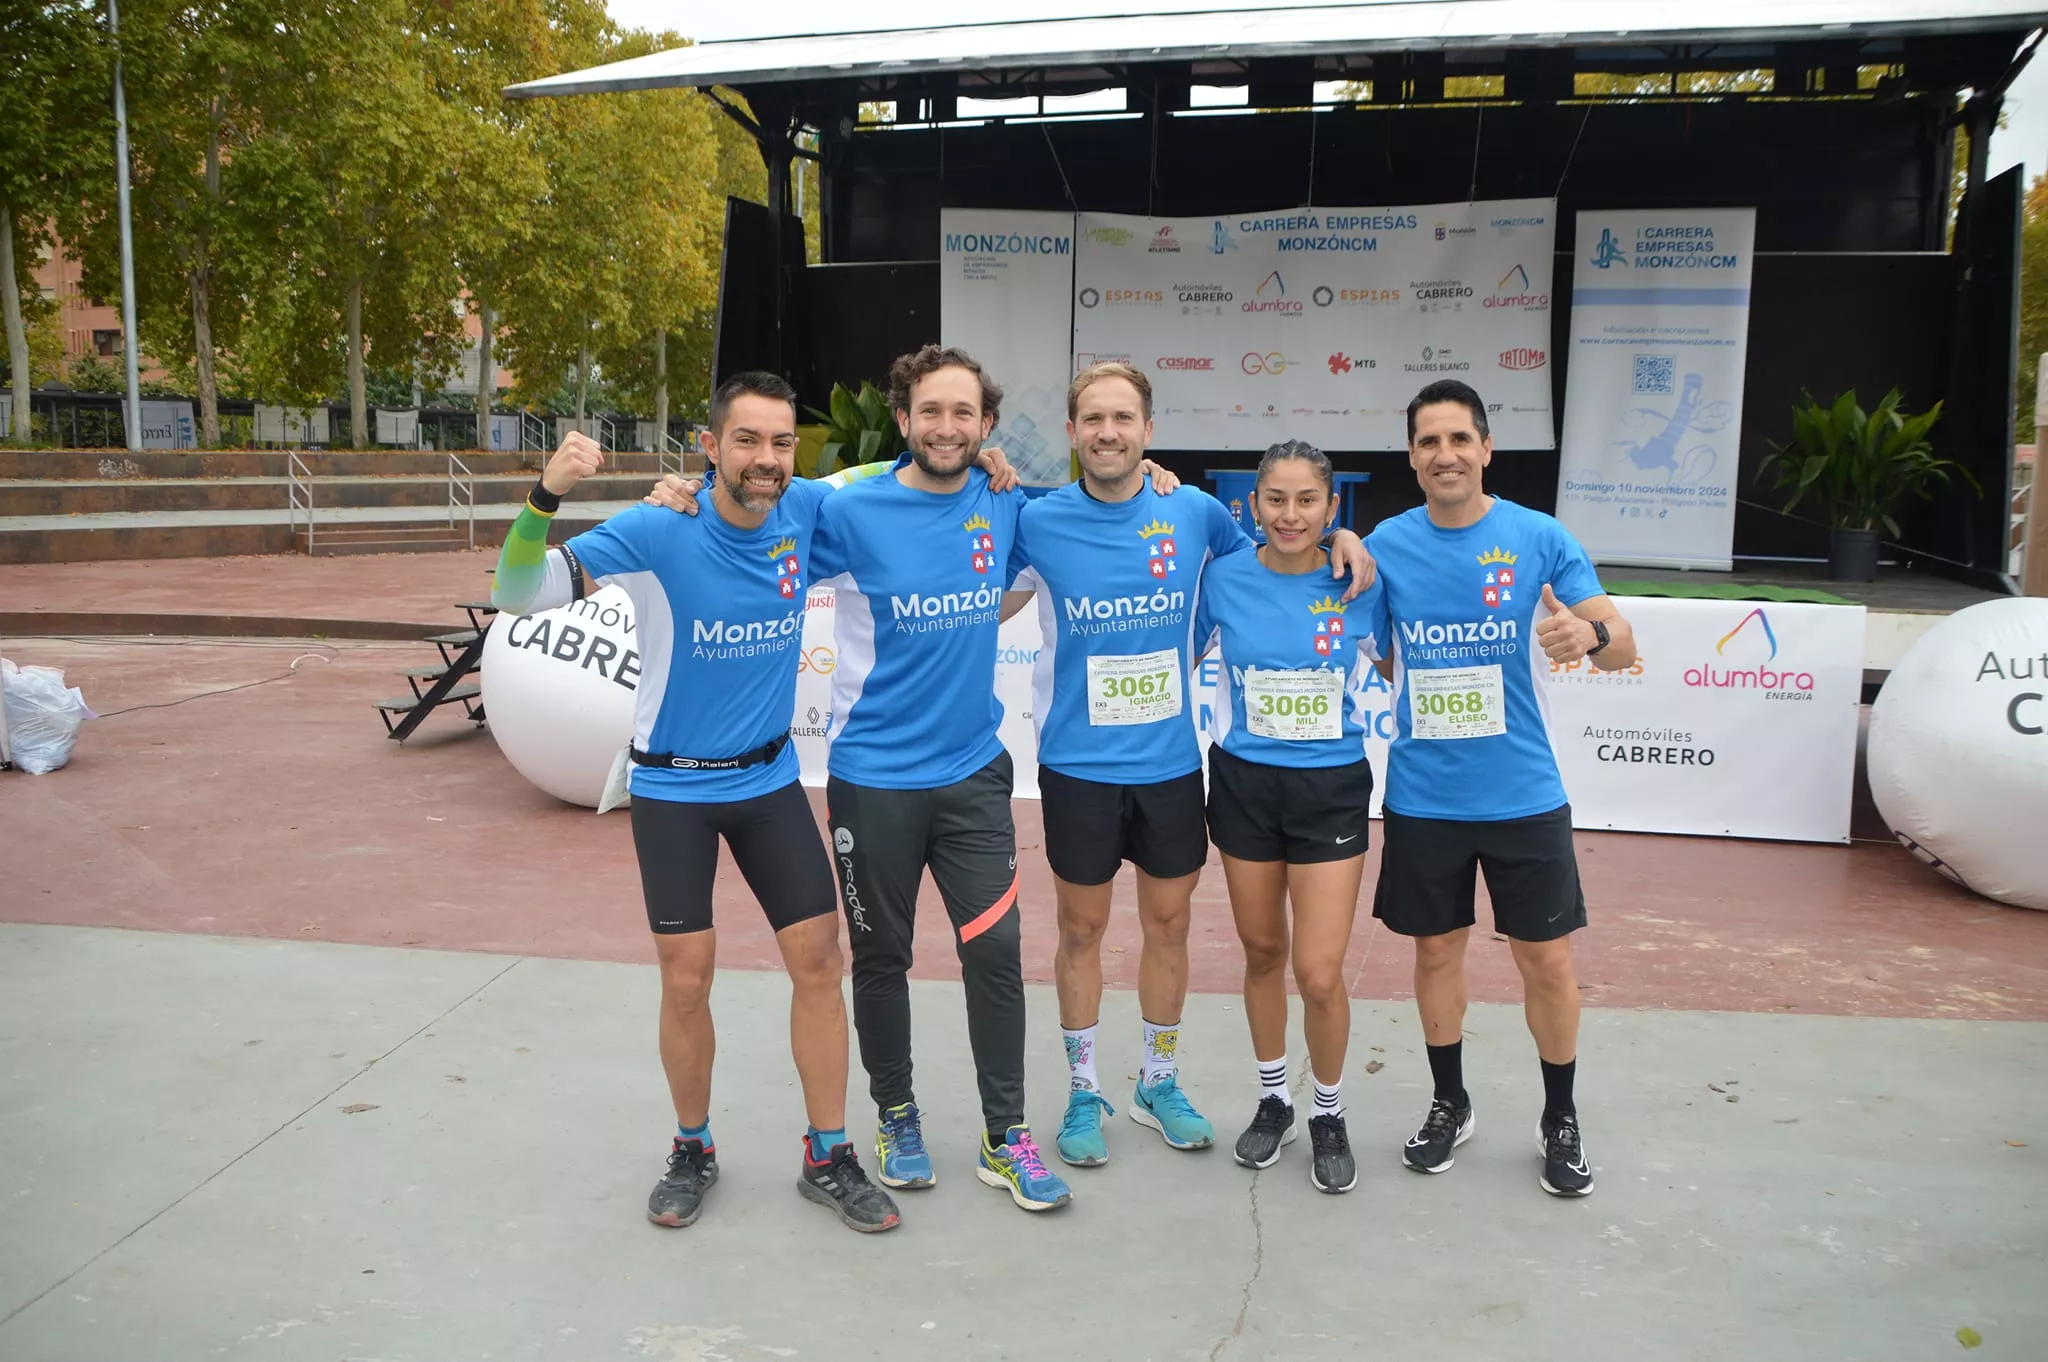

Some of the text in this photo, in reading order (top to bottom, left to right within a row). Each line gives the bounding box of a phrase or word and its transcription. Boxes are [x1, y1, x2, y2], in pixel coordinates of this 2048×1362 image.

[1240, 215, 1417, 233] CARRERA EMPRESAS
[1644, 227, 1714, 239] CARRERA
[945, 232, 1071, 256] MONZÓNCM
[1278, 234, 1377, 252] MONZÓNCM
[1636, 242, 1715, 253] EMPRESAS
[1634, 253, 1737, 269] MONZÓNCM
[1173, 283, 1222, 292] Automóviles
[1409, 279, 1462, 289] Automóviles
[1105, 290, 1164, 301] ESPIAS
[1178, 291, 1233, 303] CABRERO
[1340, 289, 1400, 301] ESPIAS
[1416, 287, 1474, 300] CABRERO
[1482, 293, 1548, 309] alumbra
[1241, 299, 1303, 313] alumbra
[1354, 359, 1377, 369] MTG
[1404, 361, 1470, 372] TALLERES BLANCO
[1565, 480, 1616, 494] Domingo
[1634, 485, 1696, 496] noviembre
[1698, 486, 1727, 497] 2024
[892, 582, 1002, 620] Monzón
[1064, 587, 1185, 621] Monzón
[693, 610, 805, 644] Monzón
[895, 608, 1000, 636] Ayuntamiento
[1070, 612, 1182, 637] Ayuntamiento
[1401, 615, 1517, 645] Monzón
[1408, 643, 1518, 660] Ayuntamiento
[1102, 671, 1169, 698] 3067
[1683, 664, 1815, 690] alumbra
[1129, 692, 1171, 706] IGNACIO
[1416, 691, 1483, 715] 3068
[1765, 692, 1813, 701] ENERGÍA
[1259, 695, 1329, 716] 3066
[1296, 716, 1318, 725] MILI
[1449, 713, 1488, 724] ELISEO
[1584, 726, 1693, 743] Automóviles
[1597, 744, 1716, 766] CABRERO
